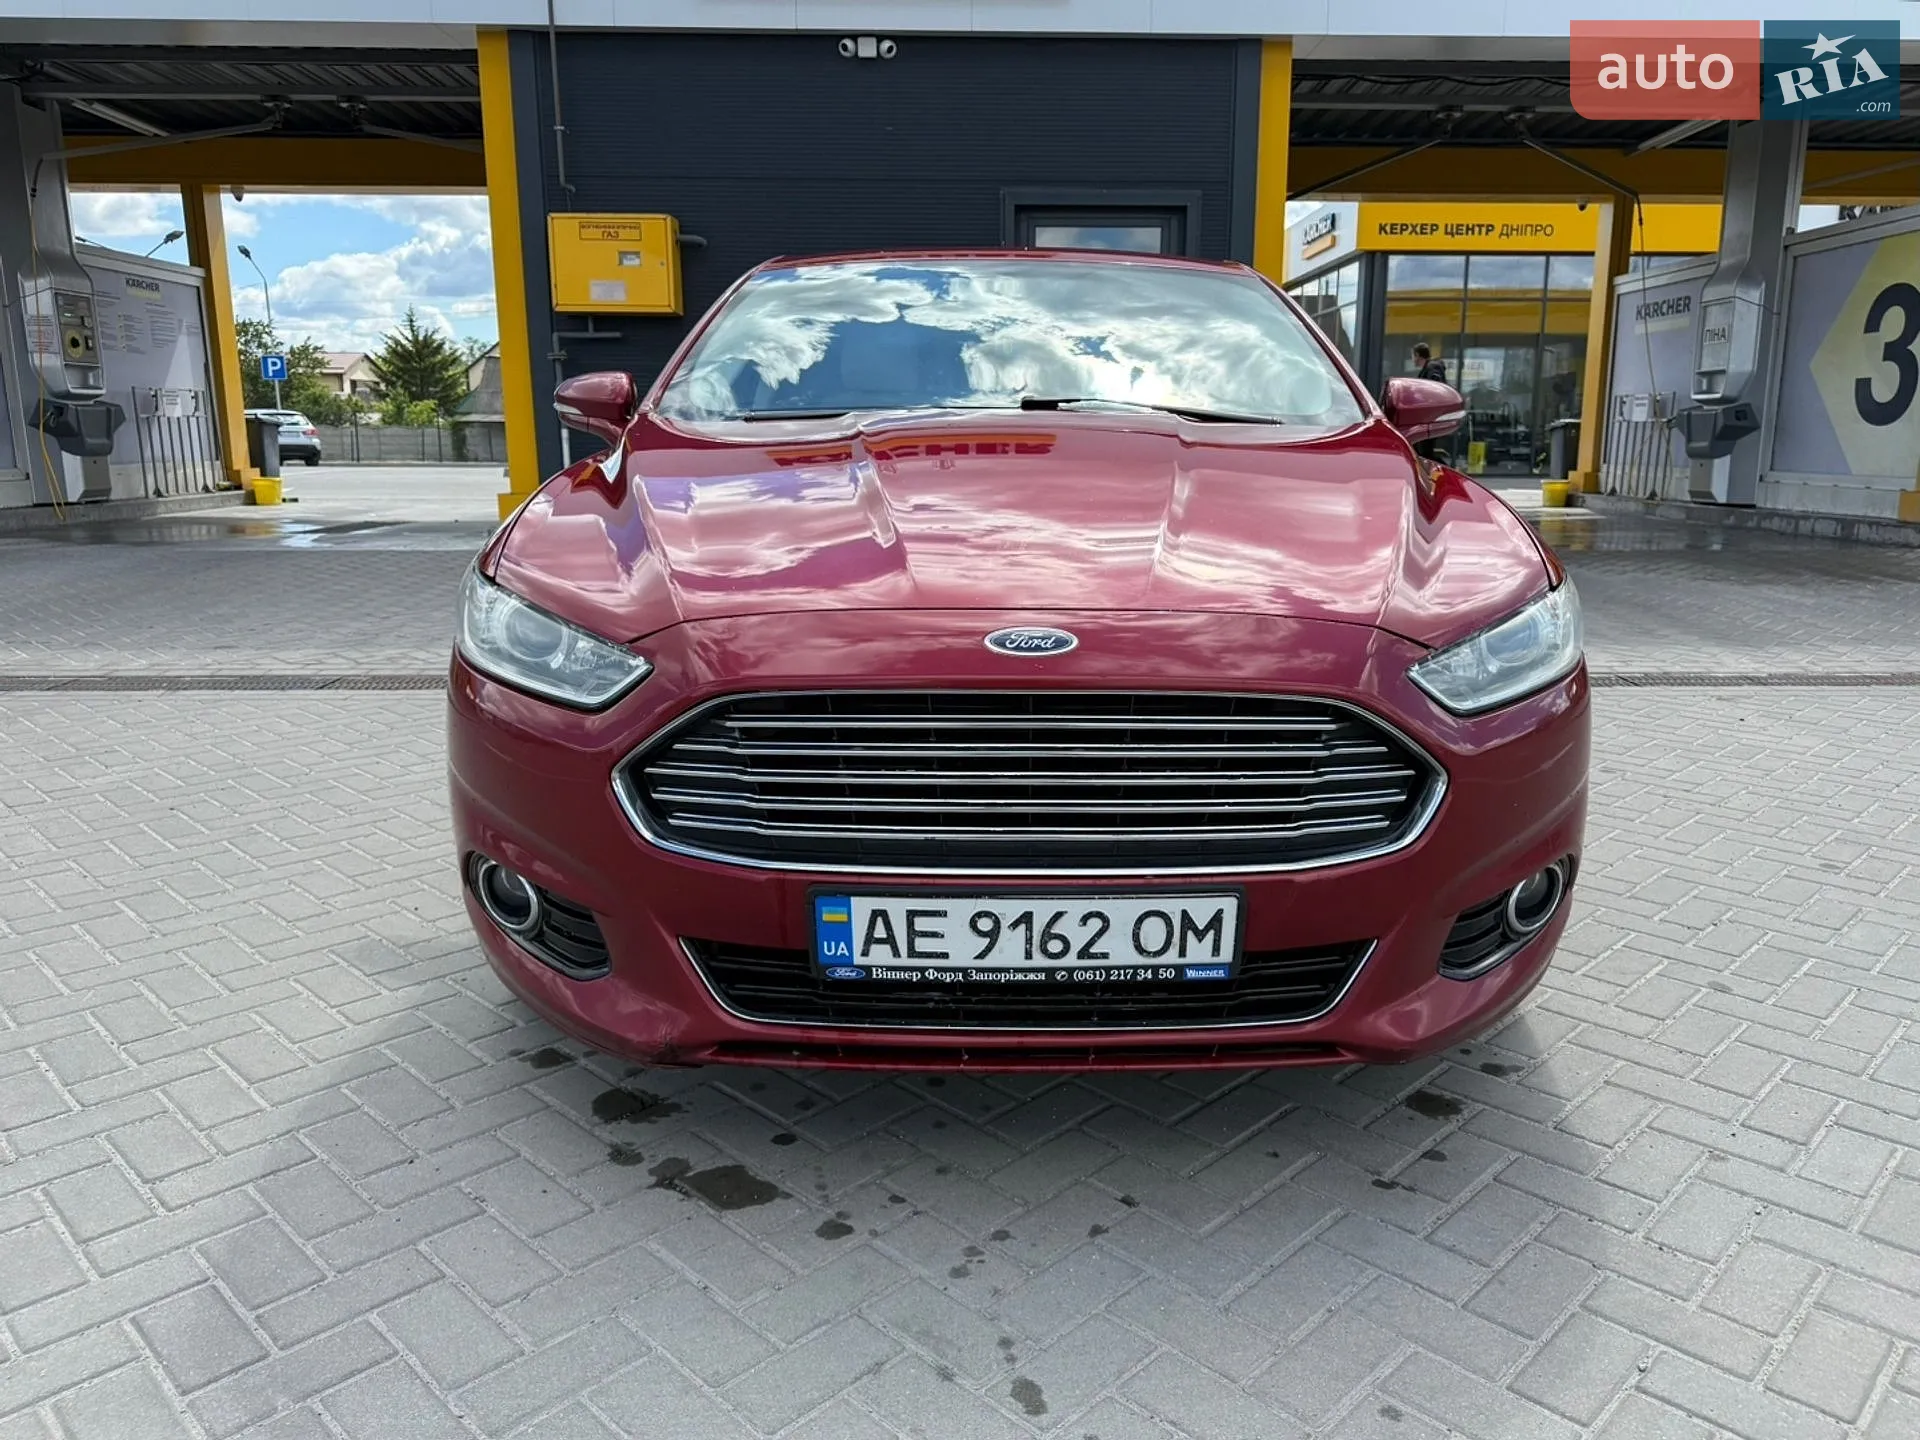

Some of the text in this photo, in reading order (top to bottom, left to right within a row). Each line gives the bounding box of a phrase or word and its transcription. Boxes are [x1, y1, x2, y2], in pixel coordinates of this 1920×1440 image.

[602, 230, 619, 239] ГАЗ
[1378, 223, 1554, 239] КЕРХЕР ЦЕНТР ДНІПРО
[1704, 327, 1726, 344] ПІНА
[1855, 282, 1920, 426] 3
[267, 358, 281, 376] P
[1005, 632, 1056, 648] Ford
[860, 908, 1224, 961] AE 9162 OM
[823, 940, 849, 957] UA
[871, 968, 1175, 982] Віннер Форд Запоріжжя (061) 217 34 50
